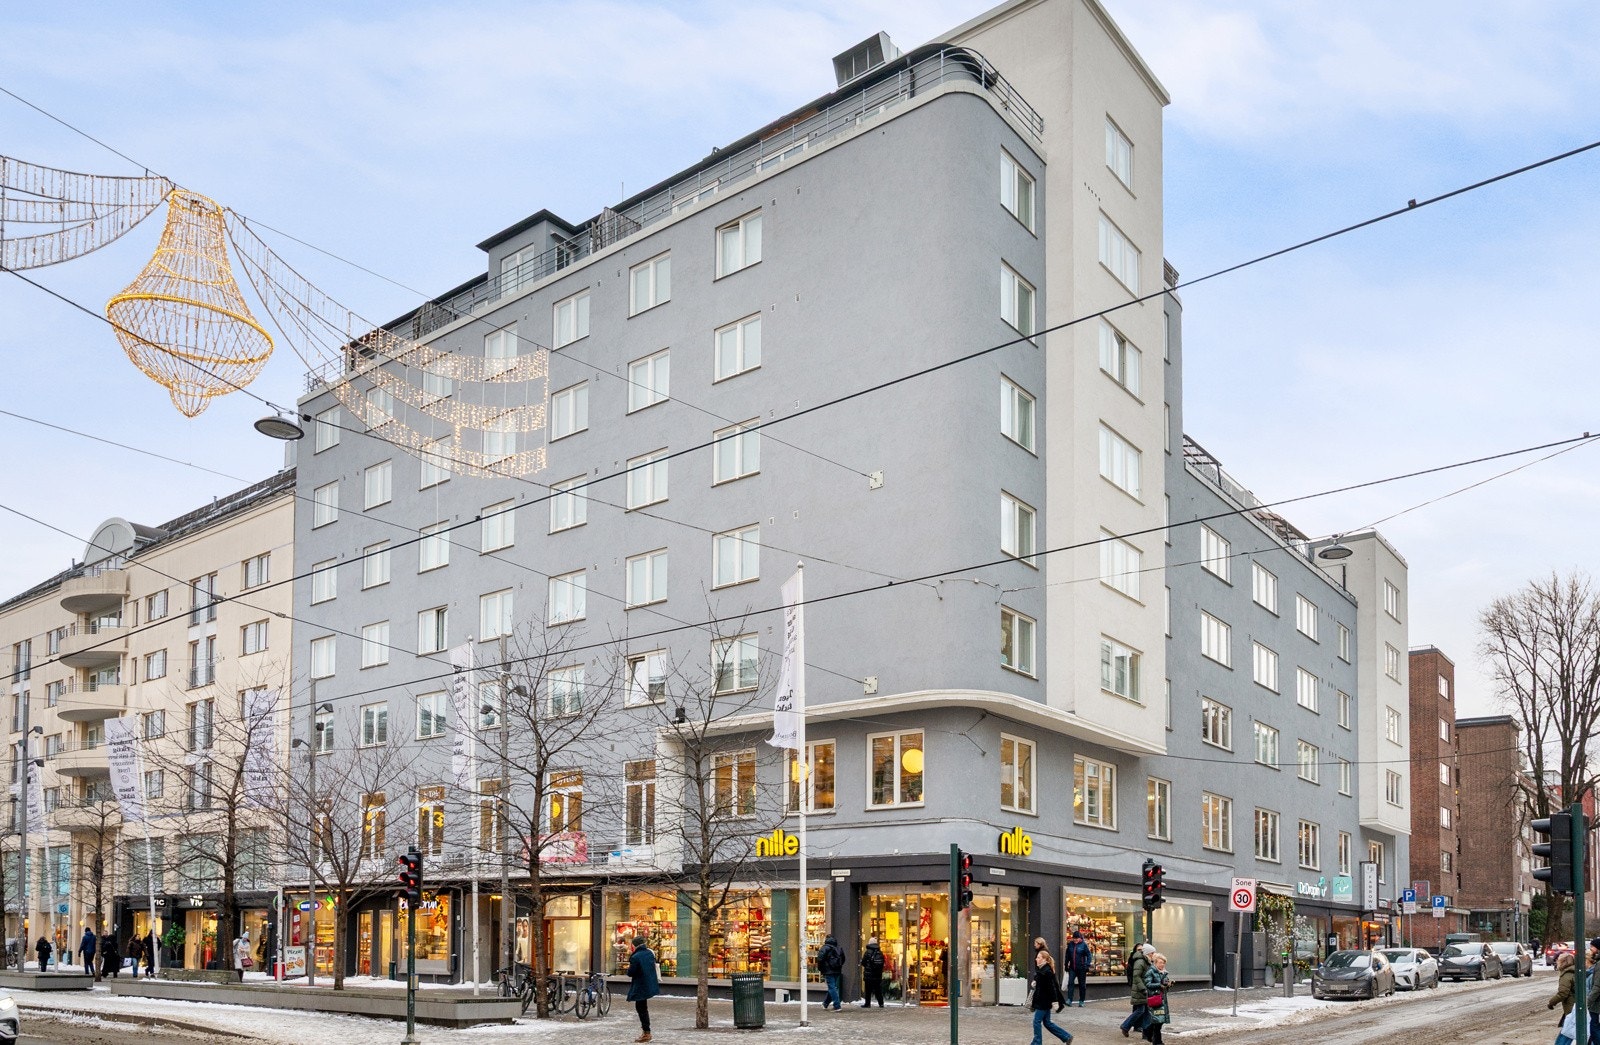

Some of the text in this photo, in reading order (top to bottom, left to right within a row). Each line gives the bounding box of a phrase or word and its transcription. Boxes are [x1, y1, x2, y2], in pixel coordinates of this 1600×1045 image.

[756, 829, 799, 857] nille
[1001, 825, 1032, 856] nille
[1236, 893, 1249, 904] 30
[1405, 891, 1413, 901] P
[1435, 897, 1442, 907] P
